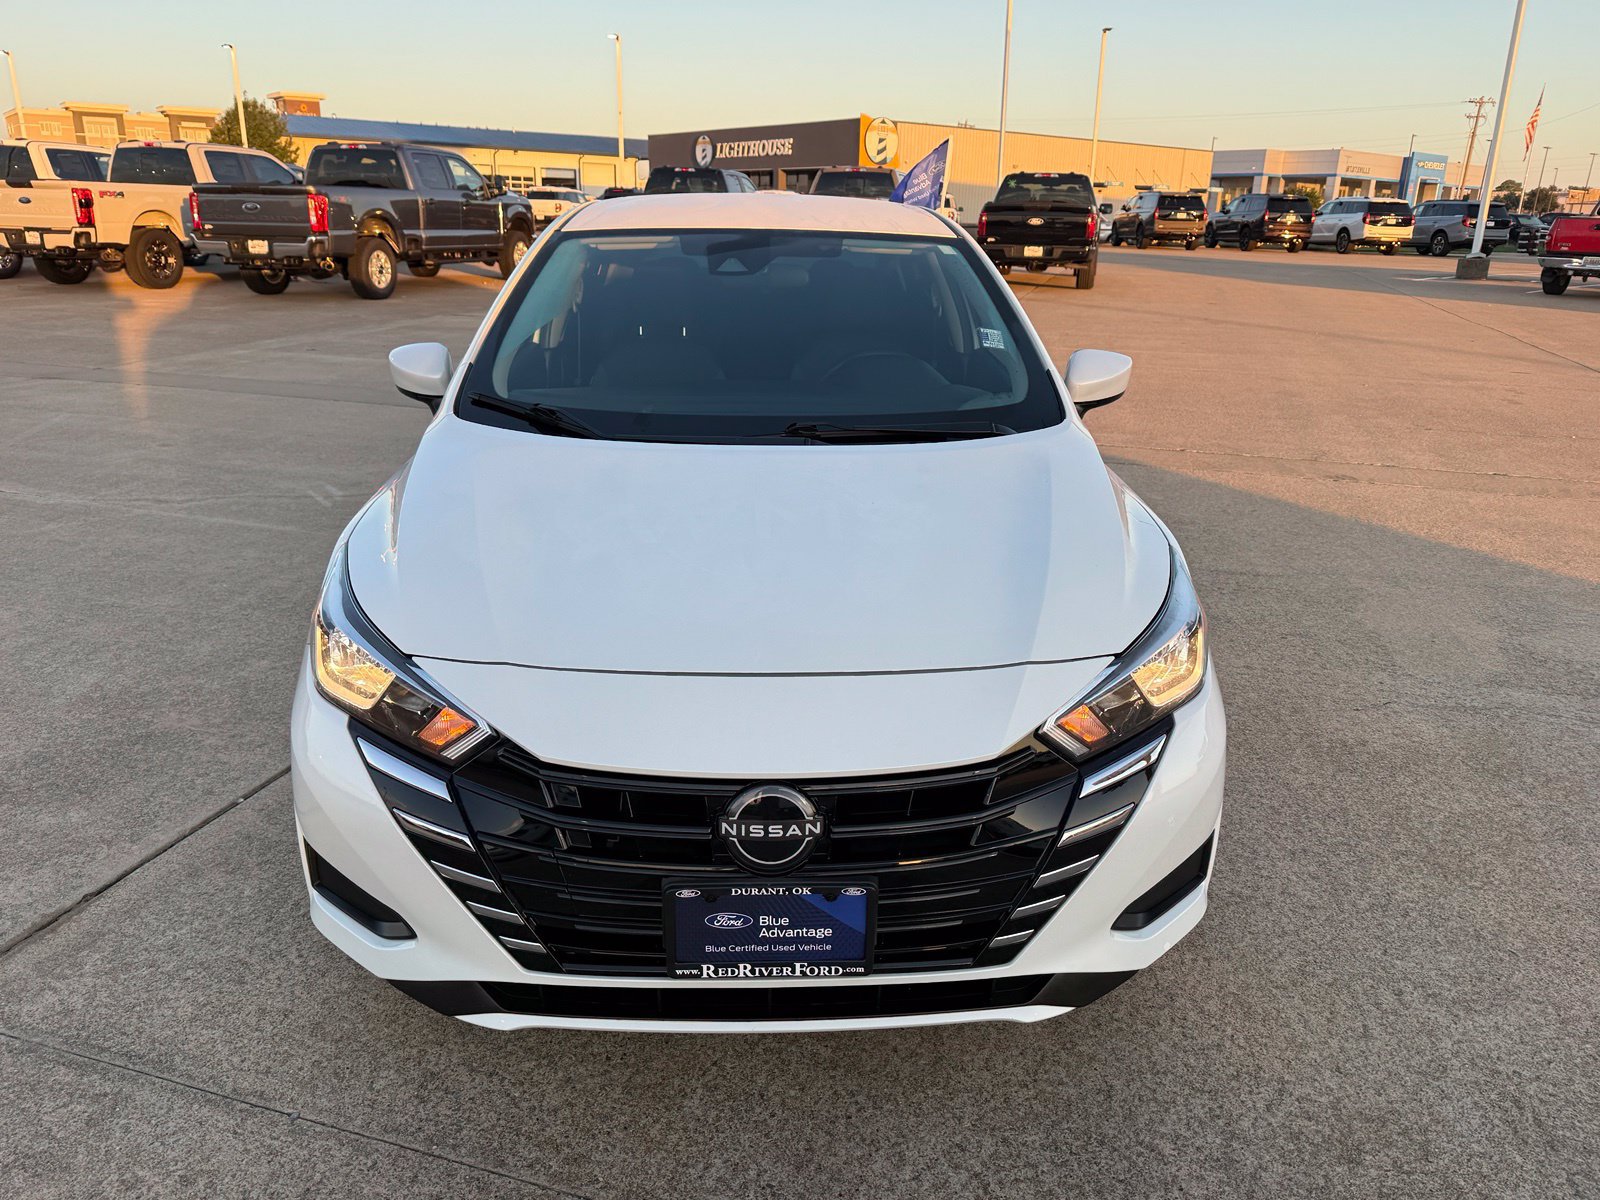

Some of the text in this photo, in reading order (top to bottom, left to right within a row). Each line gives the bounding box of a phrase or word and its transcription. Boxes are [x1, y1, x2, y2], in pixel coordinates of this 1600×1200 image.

[715, 138, 794, 159] LIGHTHOUSE
[99, 190, 125, 198] FX4
[721, 822, 821, 838] NISSAN
[731, 887, 812, 896] DURANT, OK
[713, 914, 744, 928] Ford
[759, 915, 790, 927] Blue
[758, 927, 833, 939] Advantage
[705, 943, 832, 953] Blue Certified Used Vehicle
